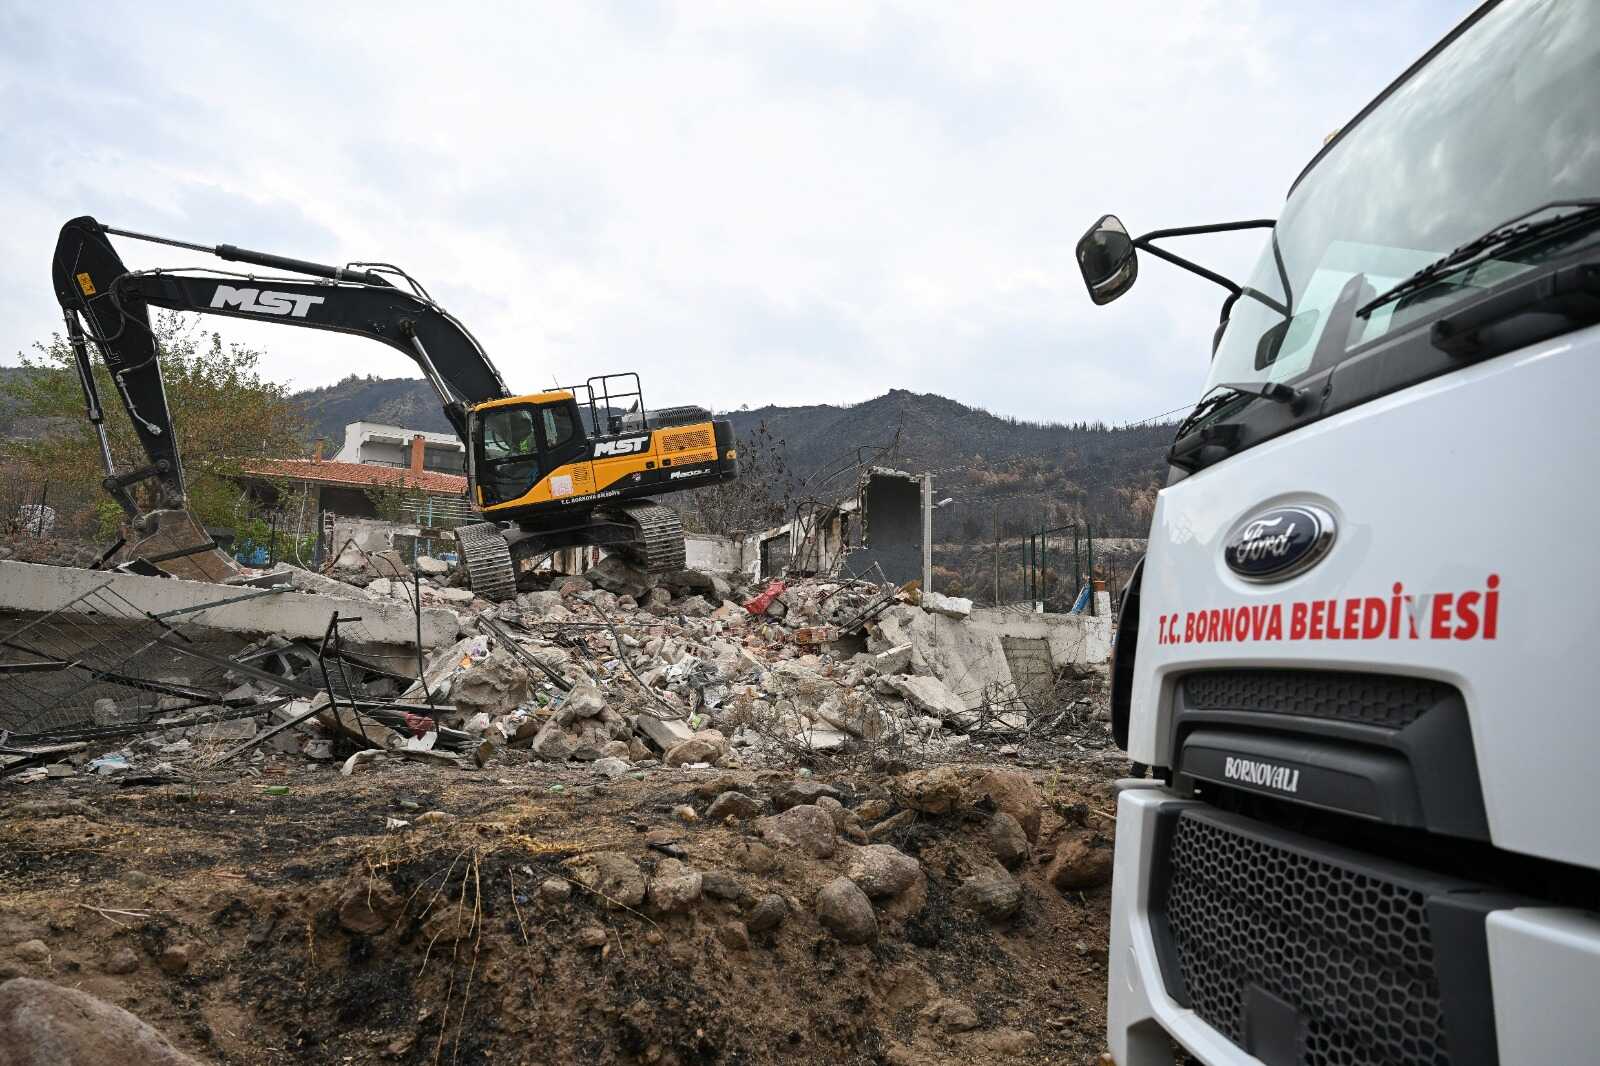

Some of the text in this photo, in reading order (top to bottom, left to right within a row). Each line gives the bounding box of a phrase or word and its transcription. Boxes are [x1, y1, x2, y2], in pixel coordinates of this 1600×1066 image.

[210, 285, 325, 318] MST
[594, 436, 648, 456] MST
[1236, 516, 1296, 563] Ford
[1159, 574, 1500, 645] T.C. BORNOVA BELEDİYESİ
[1225, 757, 1299, 792] BORNOVALI
